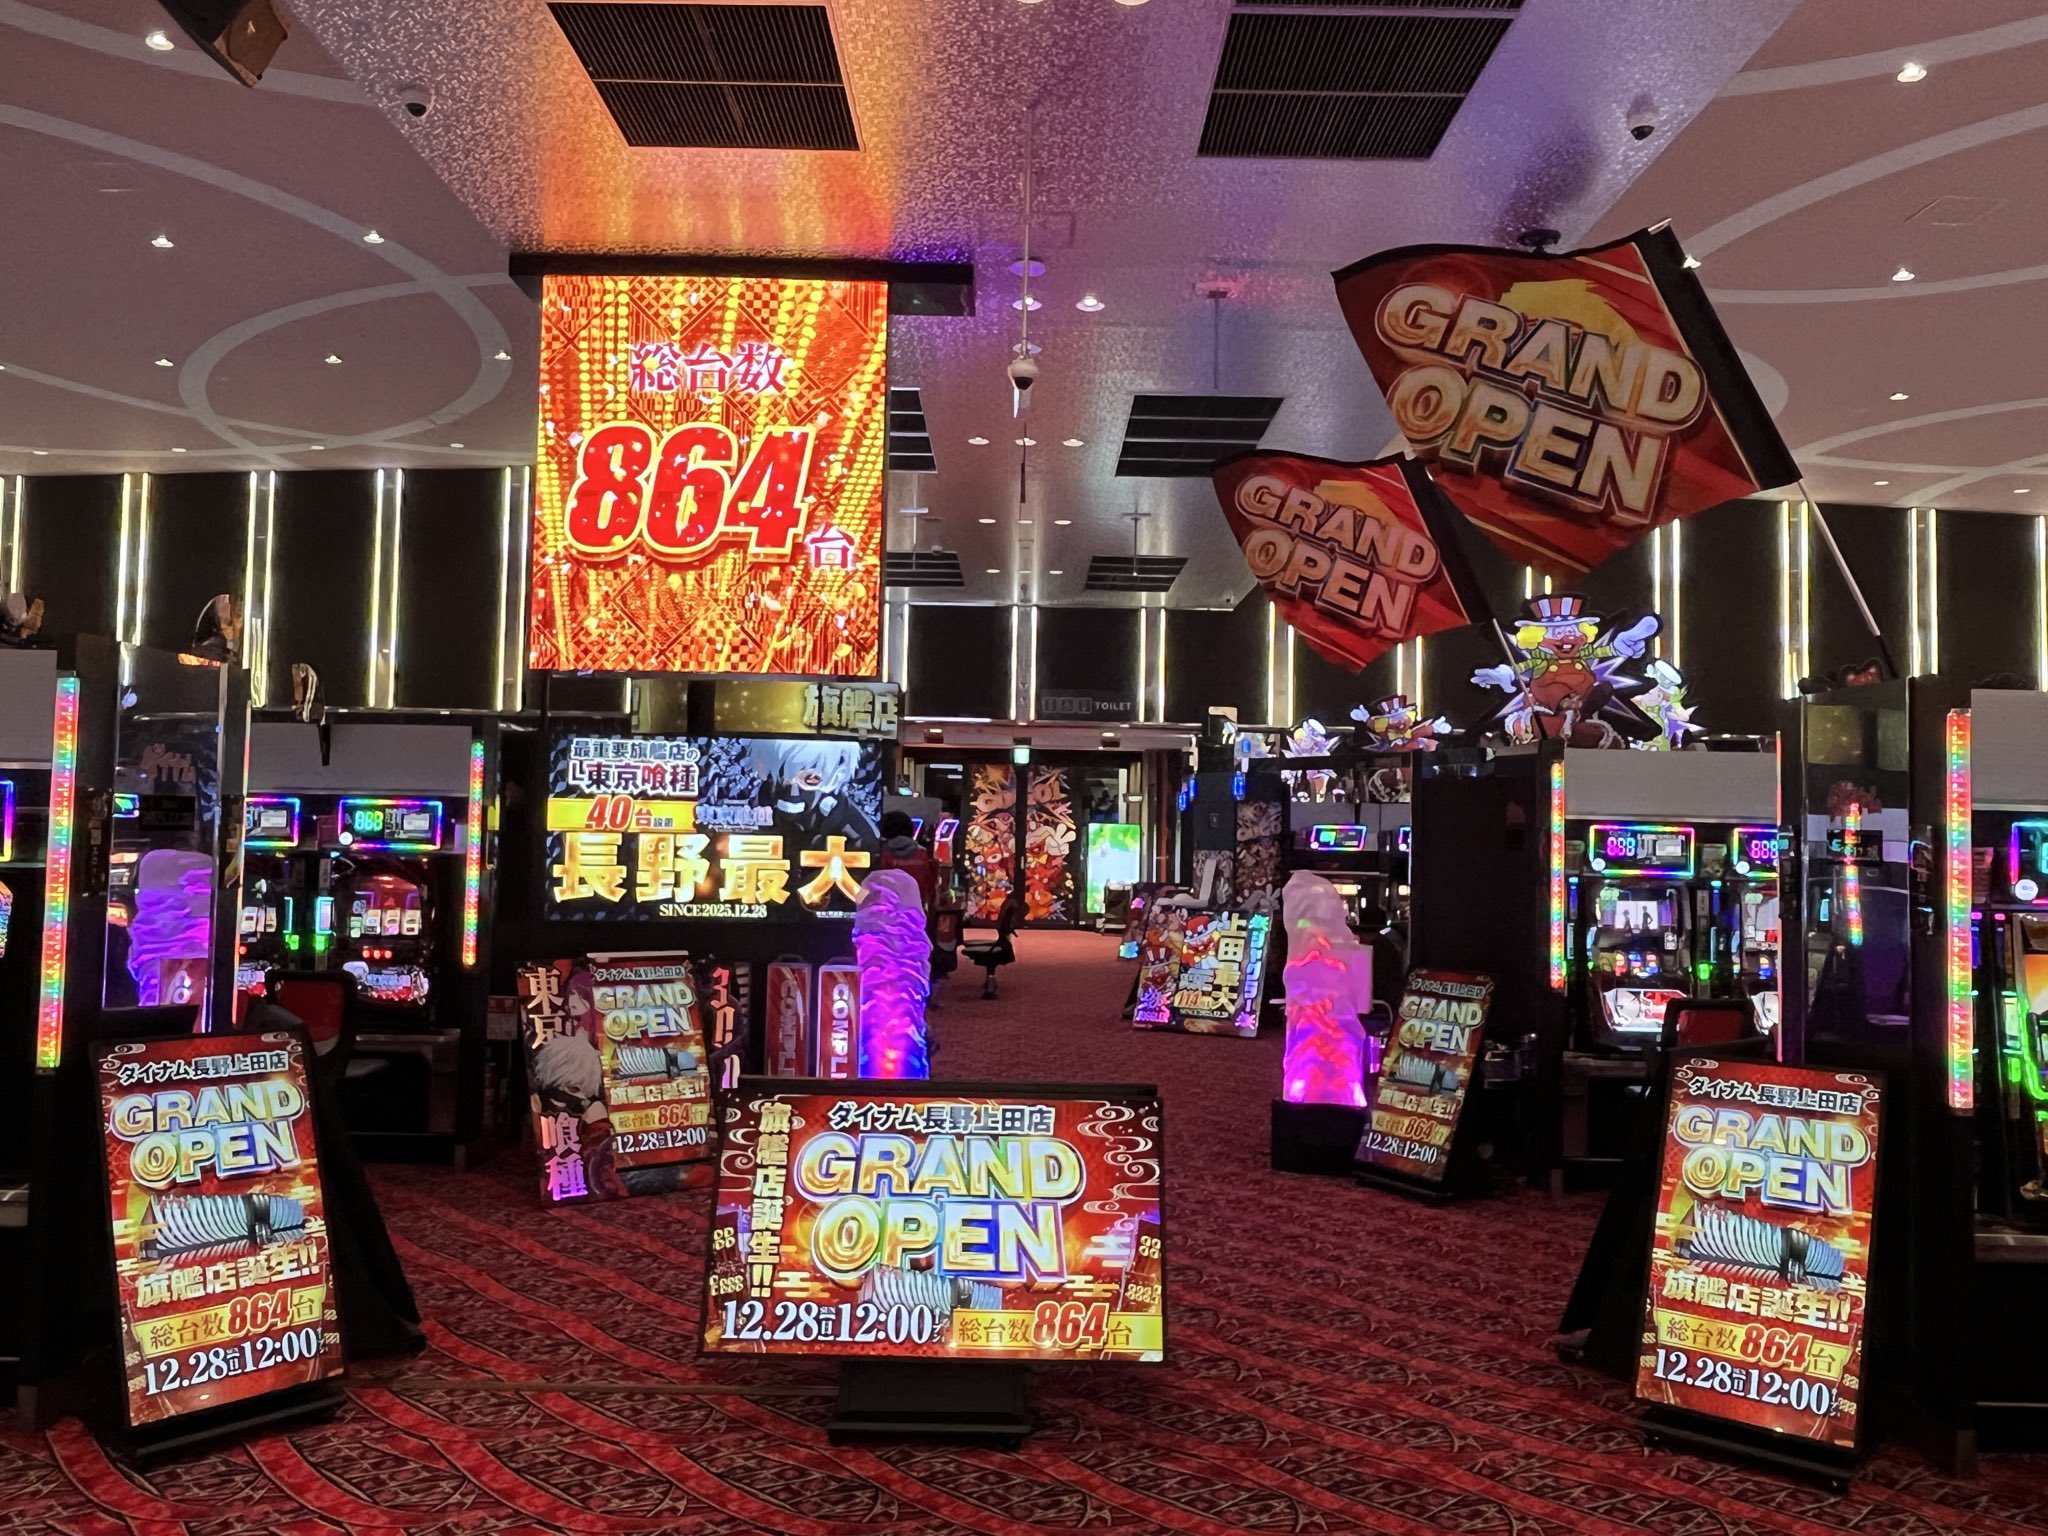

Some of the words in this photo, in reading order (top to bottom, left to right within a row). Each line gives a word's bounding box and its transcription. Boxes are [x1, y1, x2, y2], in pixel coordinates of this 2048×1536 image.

[632, 342, 786, 393] 総台数
[1378, 283, 1704, 426] GRAND
[1389, 365, 1668, 518] OPEN
[1237, 475, 1439, 580] GRAND
[1243, 526, 1414, 632] OPEN
[1094, 701, 1132, 711] TOILET
[553, 833, 871, 904] 長野最大
[593, 982, 693, 1011] GRAND
[604, 1007, 691, 1039] OPEN
[1400, 996, 1483, 1029] GRAND
[1399, 1019, 1471, 1053] OPEN
[119, 1050, 289, 1085] ダイナム長野上田店
[1690, 1076, 1863, 1115] ダイナム長野上田店
[112, 1078, 304, 1138] GRAND
[829, 1102, 1055, 1134] ダイナム長野上田店
[1674, 1107, 1869, 1167] GRAND
[130, 1119, 299, 1185] OPEN
[799, 1134, 1084, 1201] GRAND
[1683, 1147, 1853, 1214] OPEN
[815, 1200, 1064, 1276] OPEN
